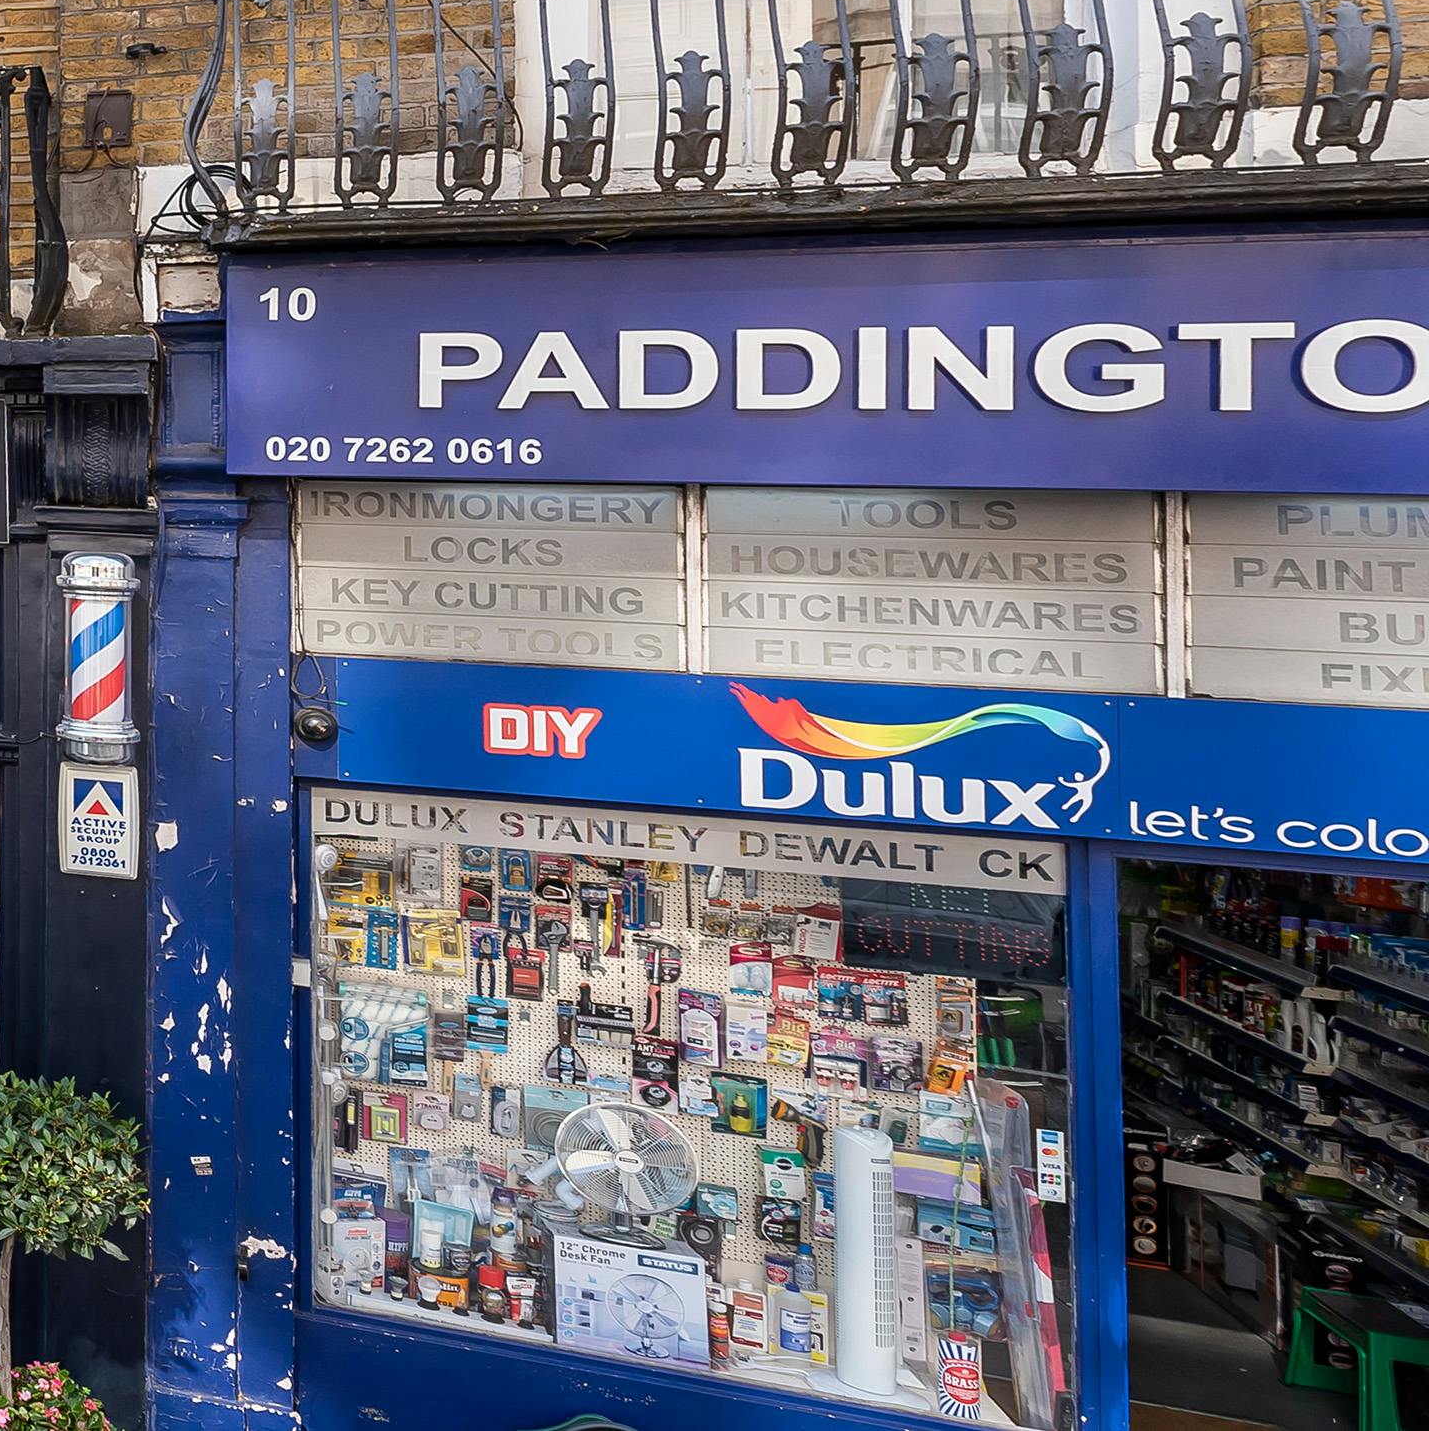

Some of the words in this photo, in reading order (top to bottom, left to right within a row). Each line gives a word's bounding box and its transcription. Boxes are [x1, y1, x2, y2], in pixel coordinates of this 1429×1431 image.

[258, 286, 318, 322] 10
[418, 318, 1429, 414] PADDINGTO
[265, 435, 331, 462] 020
[343, 437, 435, 464] 7262
[446, 438, 543, 465] 0616
[310, 490, 665, 525] IRONMONGERY
[829, 498, 1018, 531] TOOLS
[403, 536, 564, 567] LOCKS
[730, 545, 1128, 585] HOUSEWARES
[1232, 556, 1416, 592] PAINT
[330, 577, 421, 607] KEY
[434, 581, 645, 616] CUTTING
[720, 591, 1142, 634] KITCHENWARES
[315, 619, 483, 651] POWER
[498, 626, 664, 662] TOOLS
[754, 638, 1107, 679] ELECTRICAL
[485, 704, 600, 758] DIY
[737, 747, 1060, 830] Dulux
[70, 826, 126, 838] SECURITY
[71, 817, 126, 829] ACTIVE
[324, 797, 469, 834] DULUX
[498, 812, 708, 853] STANLEY
[740, 830, 944, 872] DEWALT
[978, 848, 1056, 882] CK
[1128, 800, 1256, 843] let's
[1276, 818, 1429, 857] colo
[77, 835, 120, 845] GROUP
[81, 847, 116, 858] 0800
[71, 854, 126, 869] 7312361
[819, 972, 857, 983] LOCTITE
[862, 978, 900, 987] LOCTITE
[637, 1044, 654, 1053] ANT
[1042, 1162, 1062, 1170] VISA
[560, 1250, 587, 1261] Desk
[590, 1254, 611, 1265] Fan
[582, 1245, 626, 1260] Chrome
[642, 1257, 695, 1272] STATUS
